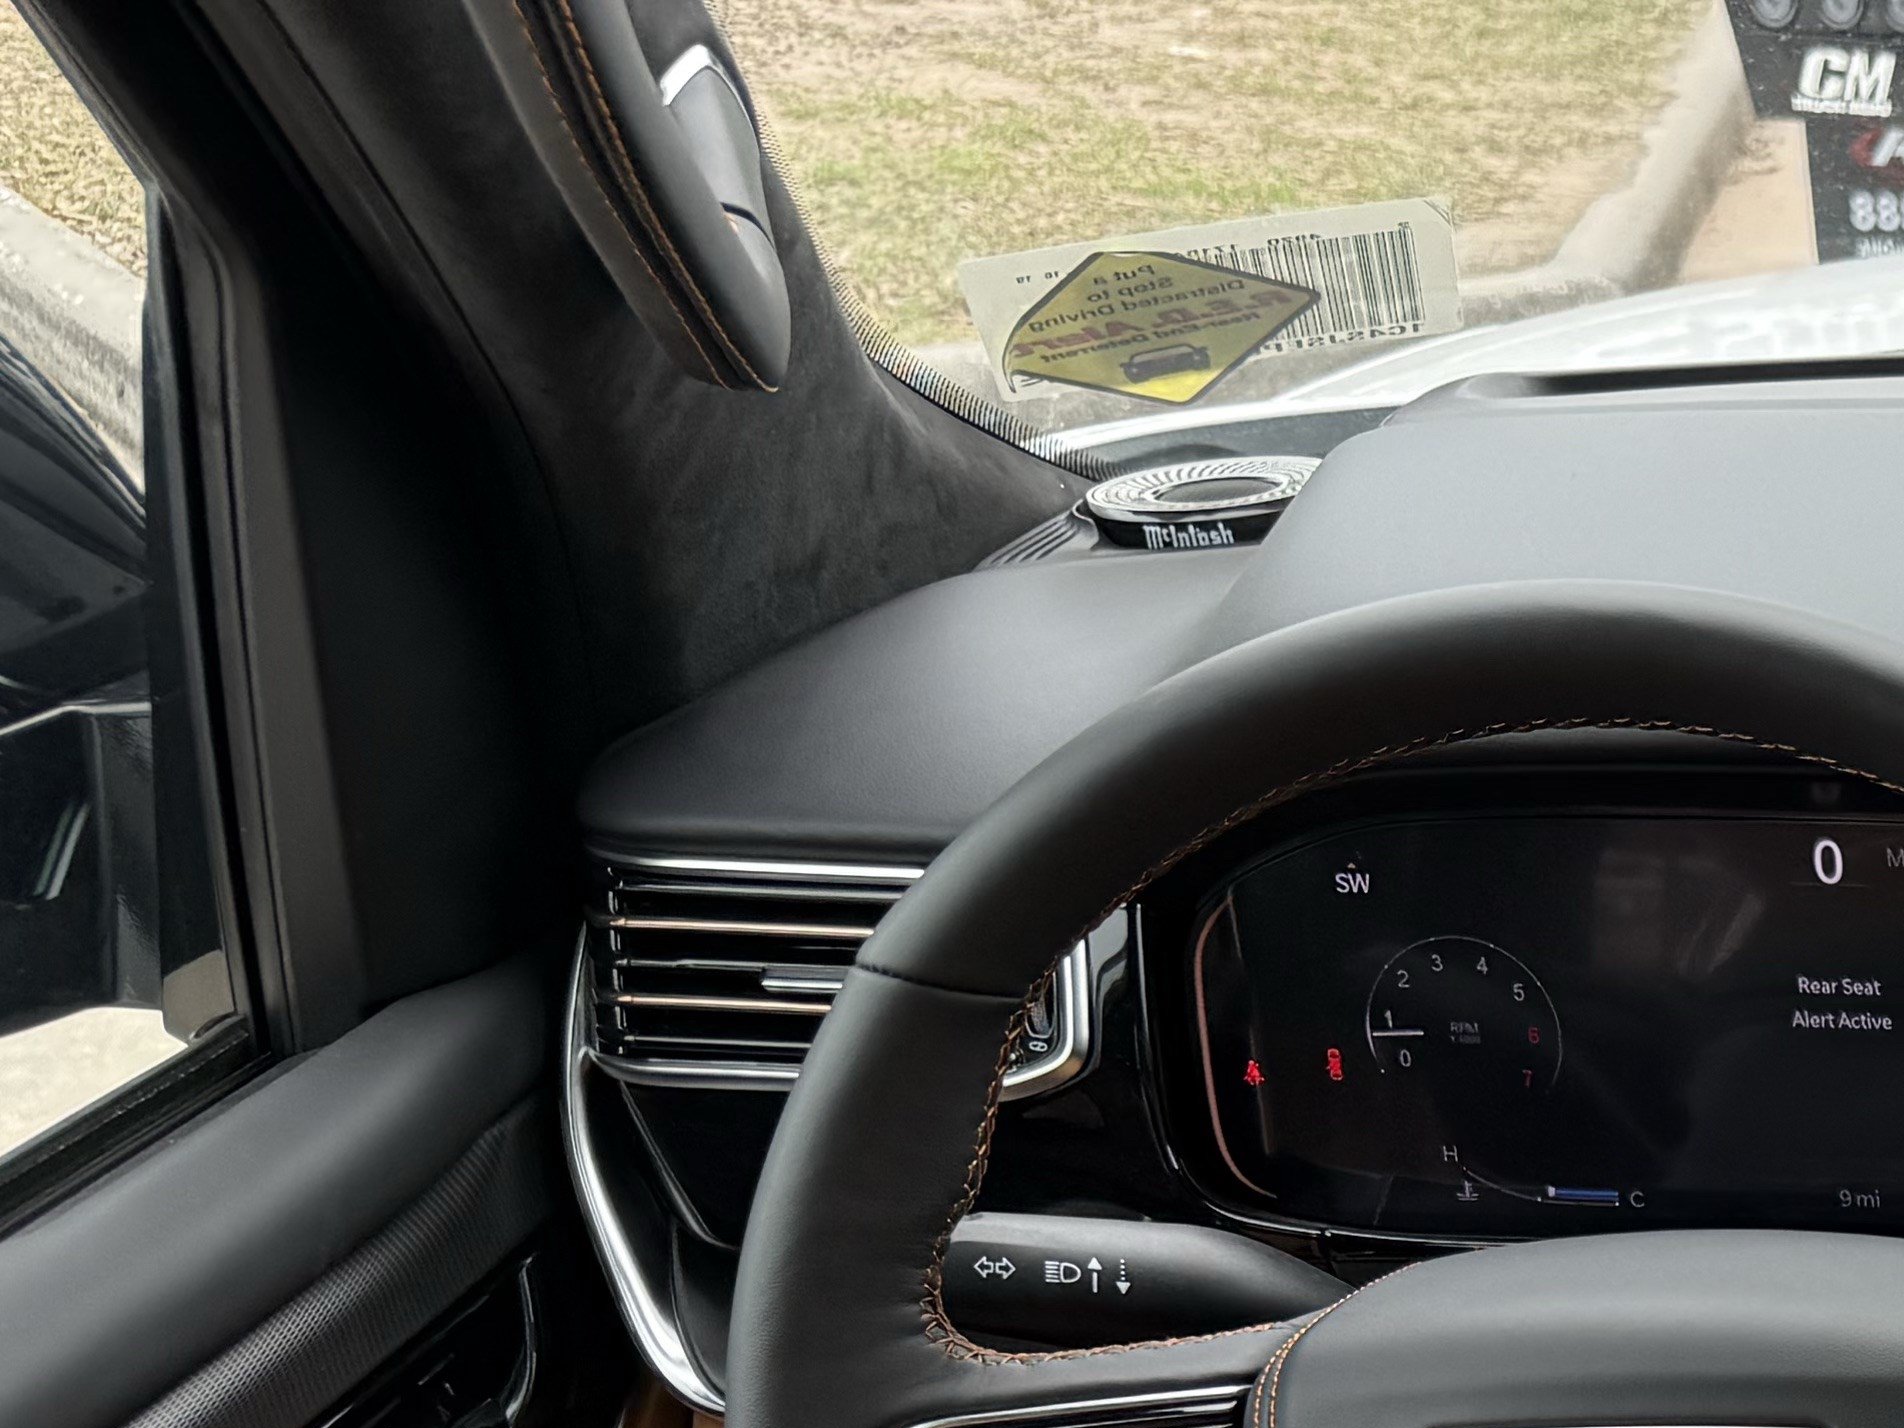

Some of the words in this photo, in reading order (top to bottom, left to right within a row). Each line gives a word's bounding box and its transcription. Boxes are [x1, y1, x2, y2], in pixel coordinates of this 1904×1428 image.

[1801, 48, 1897, 100] CM
[1143, 521, 1234, 549] McIntosh
[1813, 838, 1844, 885] 0
[1335, 873, 1370, 894] SW
[1431, 954, 1443, 972] 3
[1476, 957, 1488, 975] 4
[1397, 970, 1410, 988] 2
[1798, 976, 1838, 995] Rear
[1842, 978, 1882, 996] Seat
[1512, 983, 1525, 1001] 5
[1384, 1009, 1393, 1029] 1
[1792, 1010, 1835, 1029] Alert
[1838, 1012, 1893, 1031] Active
[1527, 1026, 1540, 1045] 6
[1400, 1049, 1413, 1068] 0
[1443, 1145, 1458, 1161] H
[1630, 1190, 1645, 1208] C
[1839, 1190, 1850, 1208] 9
[1855, 1189, 1881, 1207] mi
